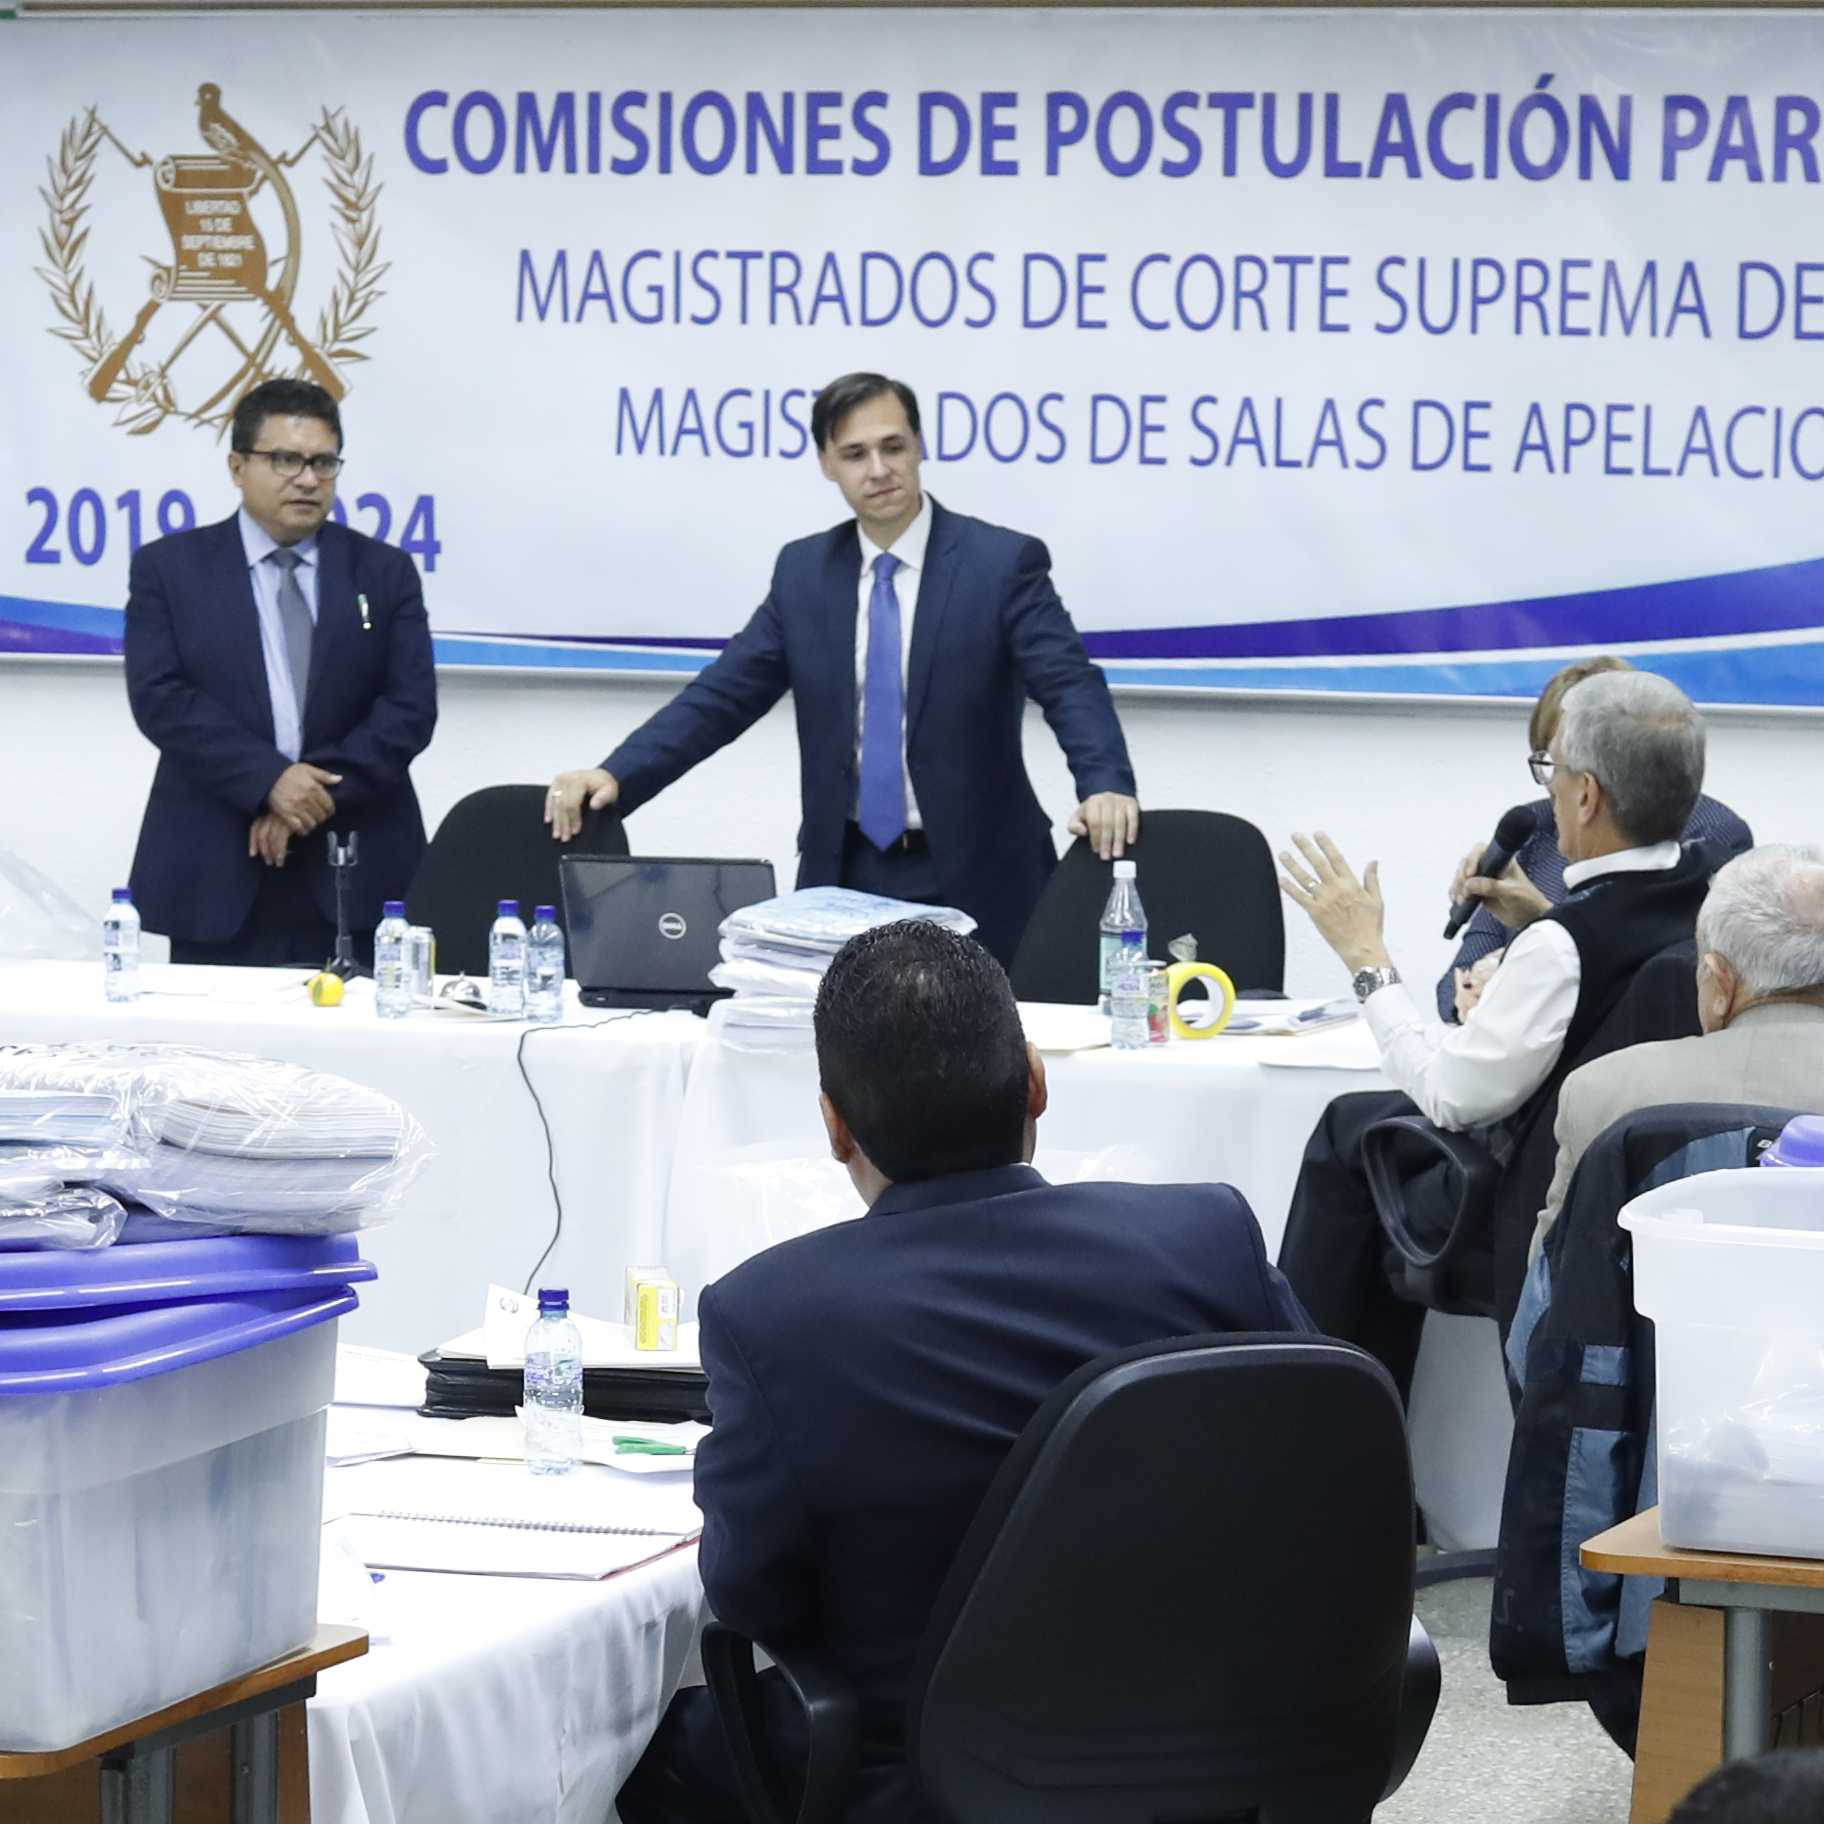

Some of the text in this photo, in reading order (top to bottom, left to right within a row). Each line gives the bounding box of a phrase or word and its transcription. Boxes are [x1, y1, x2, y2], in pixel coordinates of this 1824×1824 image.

[404, 89, 892, 177] COMISIONES
[918, 91, 1020, 177] DE
[1046, 73, 1633, 182] POSTULACIÓN
[516, 249, 997, 329] MAGISTRADOS
[1022, 252, 1108, 330] DE
[1131, 252, 1350, 333] CORTE
[1375, 254, 1712, 338] SUPREMA
[615, 387, 1067, 464] MAGISDOS
[1090, 393, 1167, 466] DE
[1190, 394, 1388, 471] SALAS
[1411, 399, 1492, 474] DE
